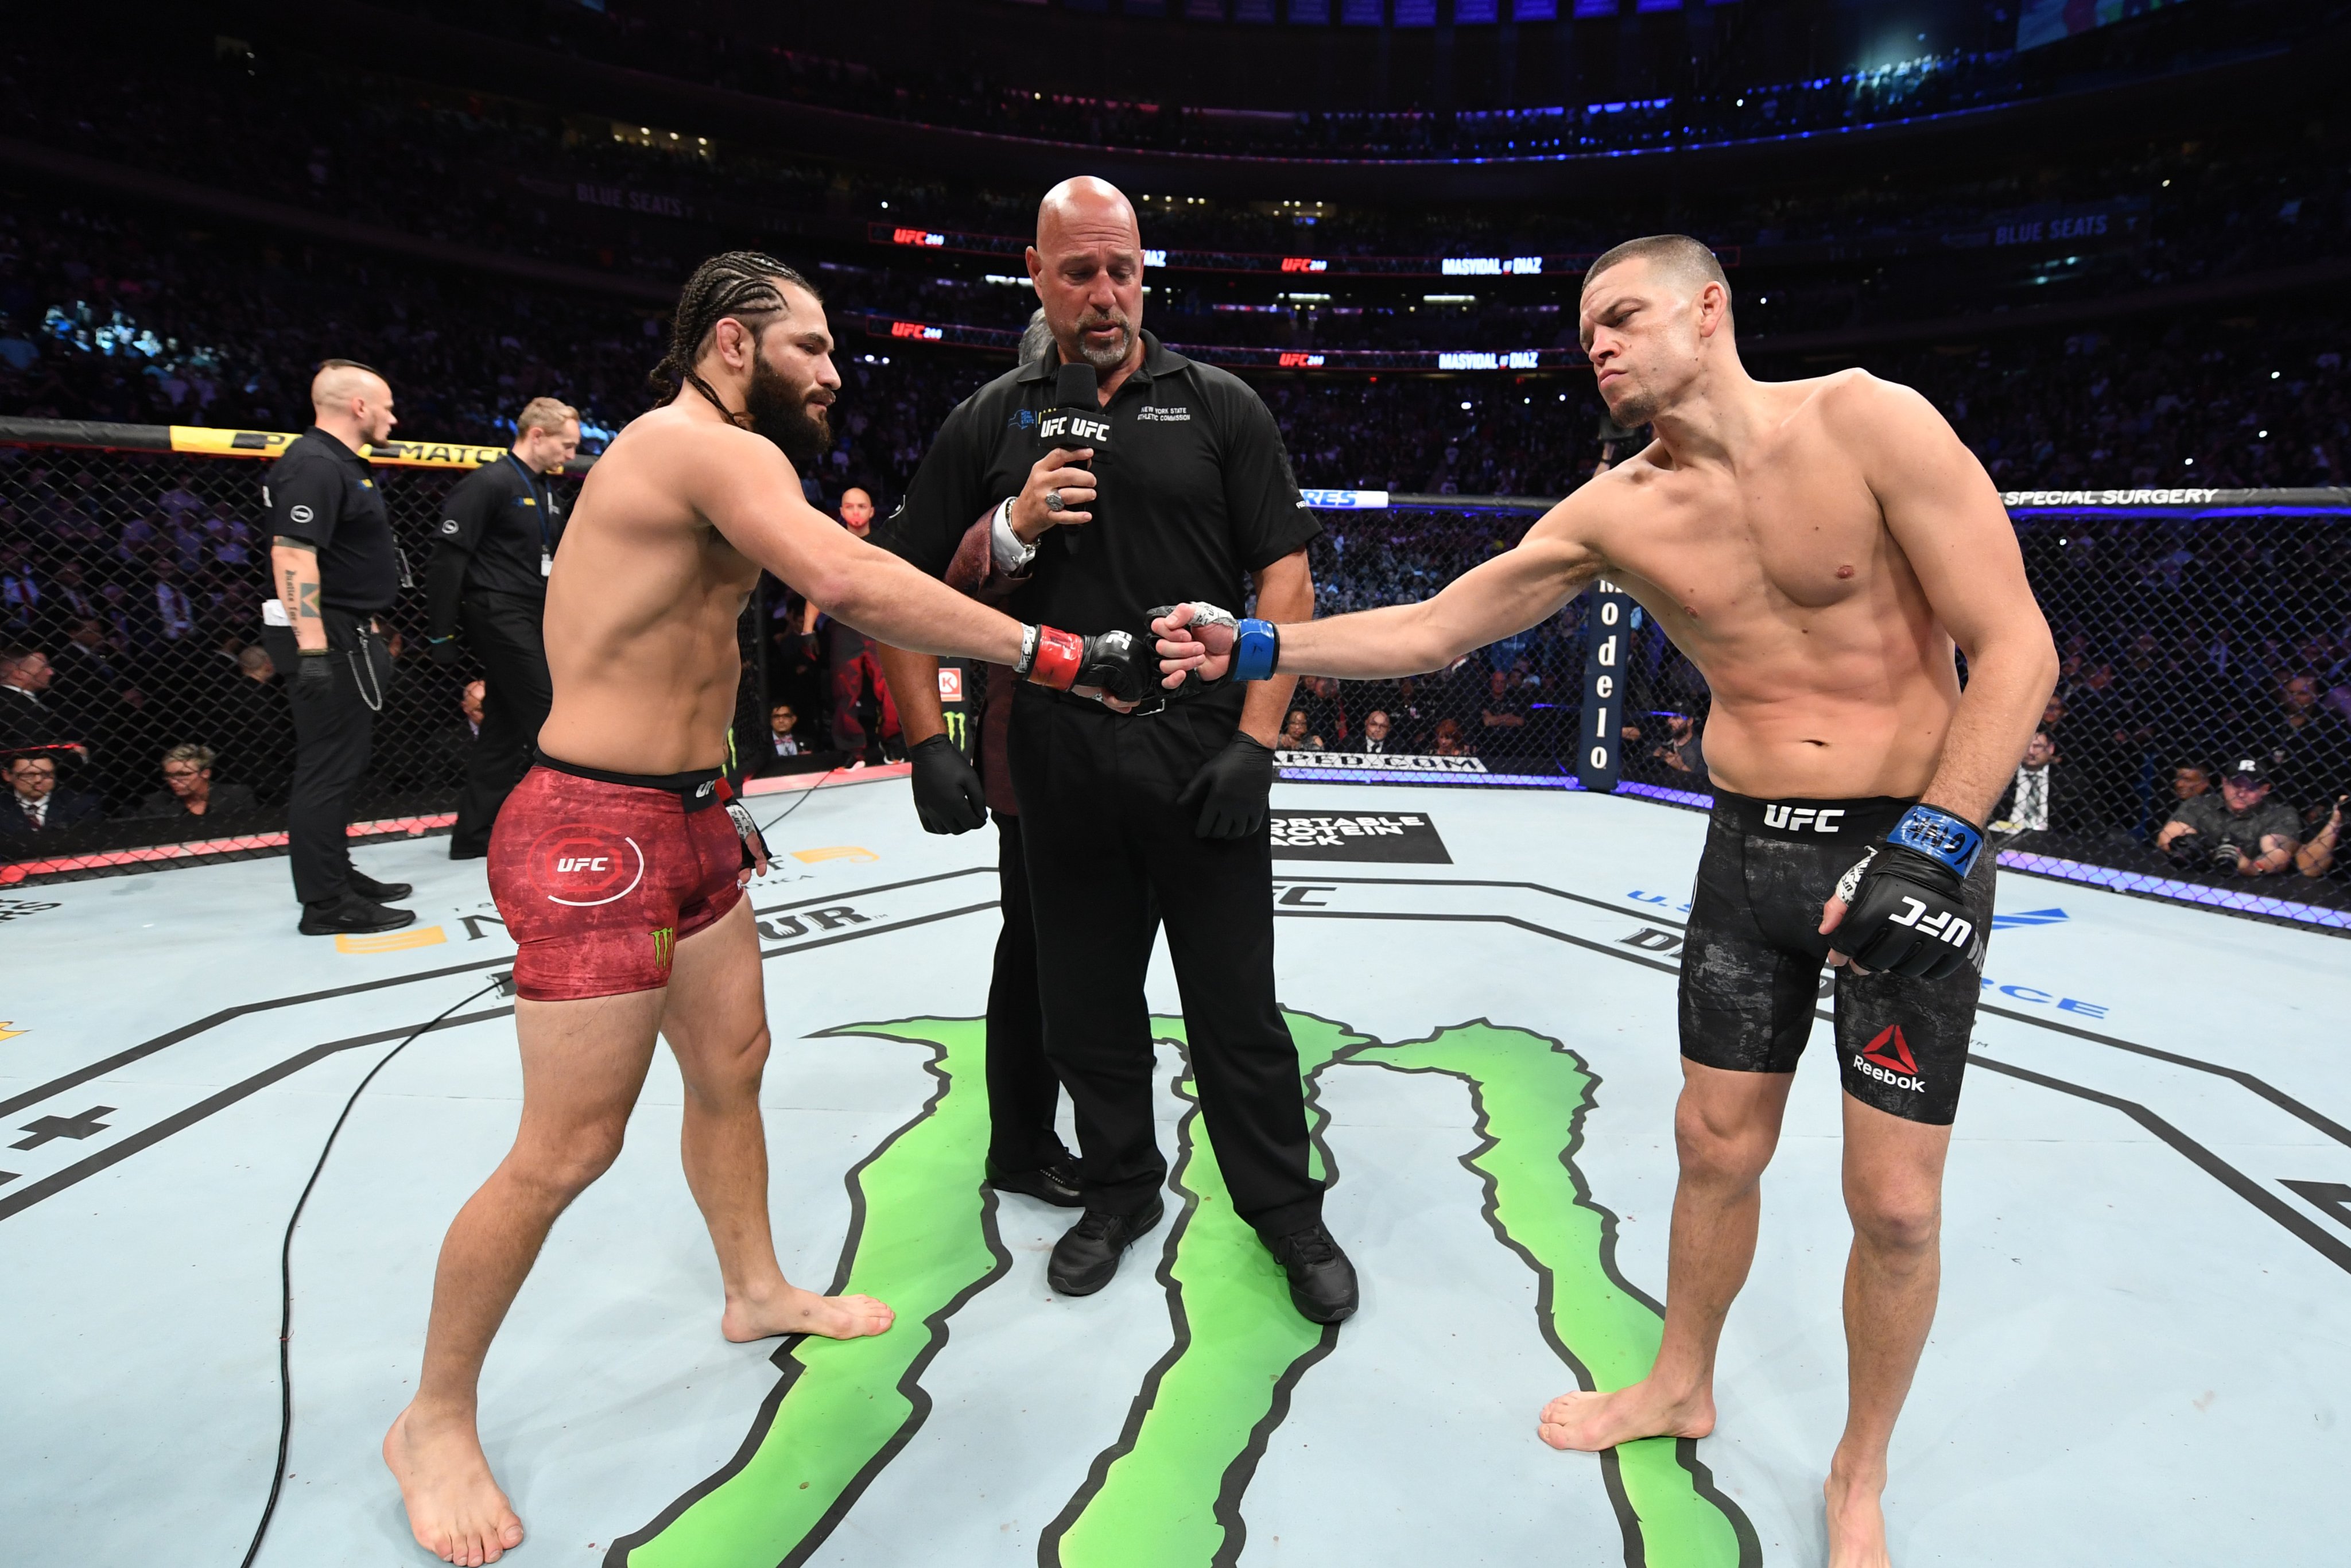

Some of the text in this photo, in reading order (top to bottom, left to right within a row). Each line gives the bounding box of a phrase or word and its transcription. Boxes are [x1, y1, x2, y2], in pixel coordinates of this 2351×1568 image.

[893, 228, 927, 246] UFC
[1995, 223, 2043, 246] BLUE
[2049, 215, 2109, 240] SEATS
[1281, 258, 1313, 273] UFC
[1442, 258, 1502, 275] MASVIDAL
[1512, 257, 1542, 274] DIAZ
[891, 321, 925, 339] UFC
[1279, 352, 1310, 367] UFC
[1438, 352, 1499, 370] MASVIDAL
[1509, 351, 1538, 368] DIAZ
[1137, 413, 1158, 421] ATHLETIC
[1040, 416, 1068, 438] UFC
[1071, 418, 1110, 441] UFC
[398, 444, 507, 463] MATC
[2004, 489, 2220, 506] SPECIAL SURGERY
[1764, 804, 1845, 832] UFC
[557, 857, 608, 872] UFC
[1888, 896, 1972, 948] UFC
[1853, 1055, 1926, 1093] Reebok
